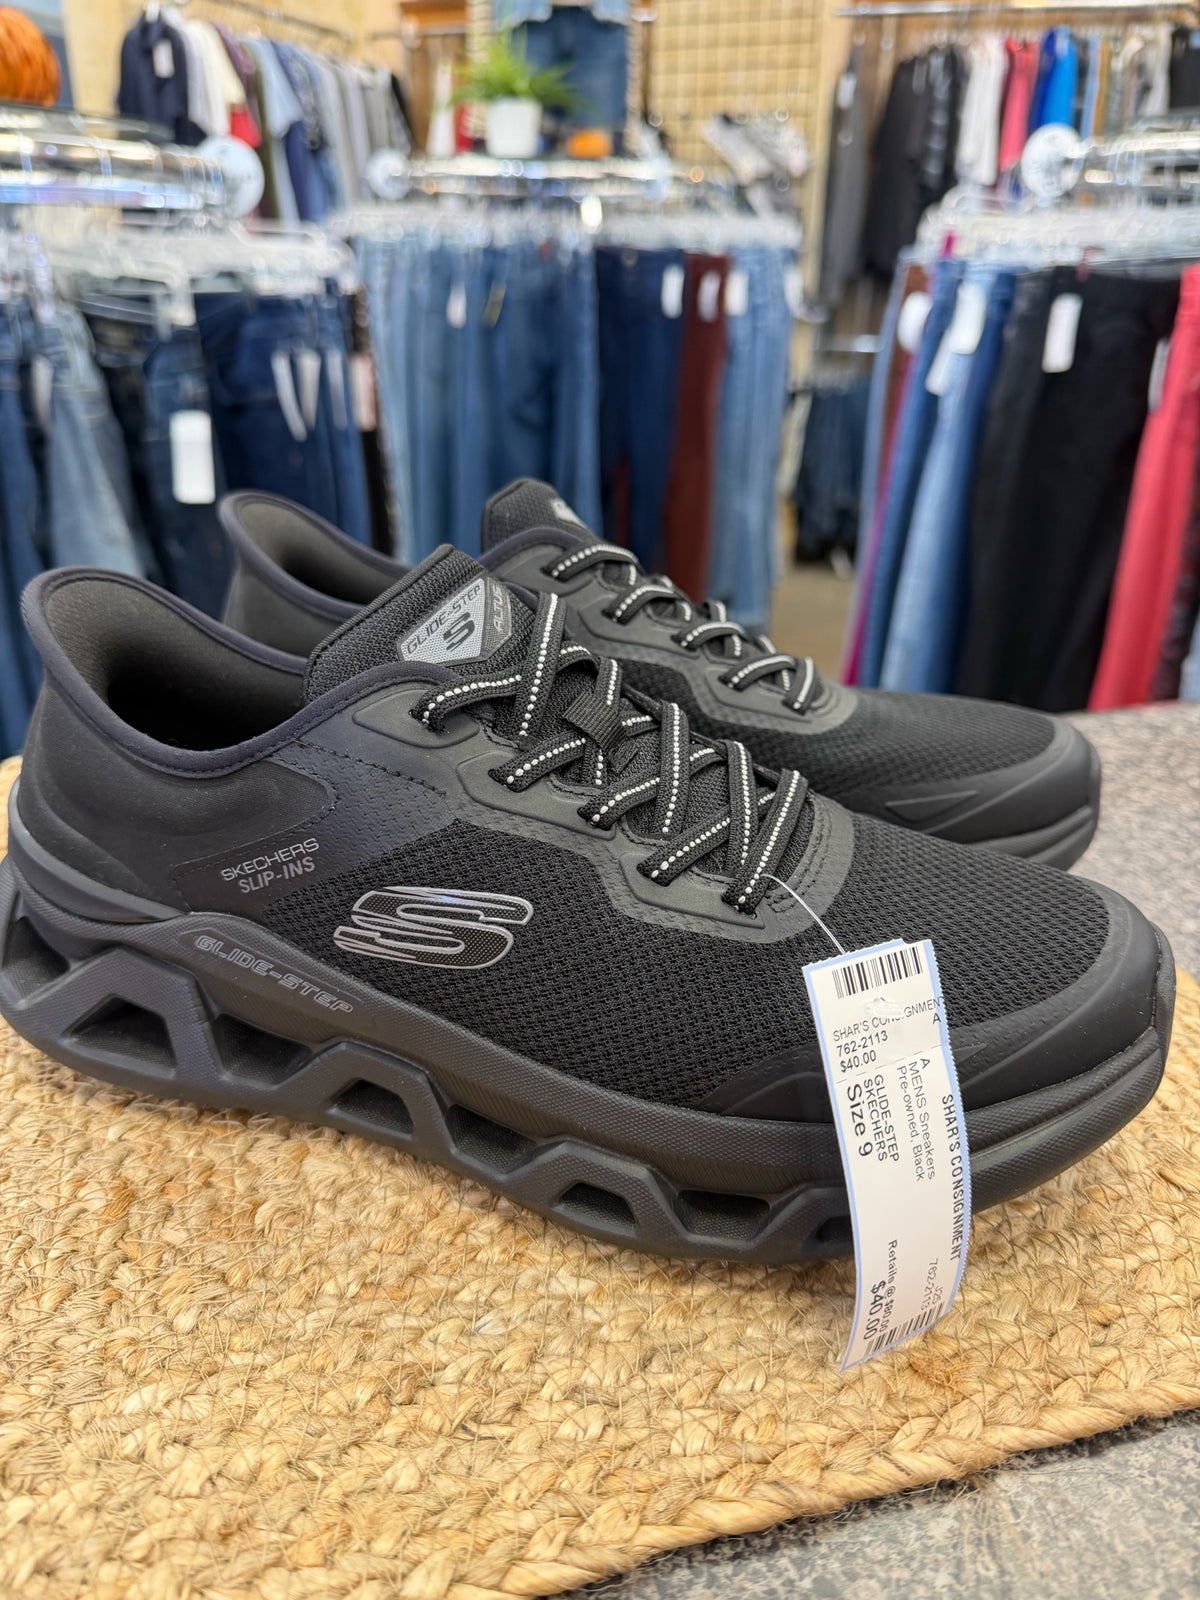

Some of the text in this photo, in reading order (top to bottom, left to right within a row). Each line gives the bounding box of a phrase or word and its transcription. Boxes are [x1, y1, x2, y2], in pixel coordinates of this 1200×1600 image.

[405, 585, 481, 655] GLIDE-STEP
[221, 838, 320, 882] SKECHERS
[238, 857, 316, 893] SLIP-INS
[194, 935, 354, 1013] GLIDE-STEP
[832, 996, 945, 1042] SHAR'S COGNMEN
[932, 1012, 942, 1025] A
[836, 1030, 889, 1058] 762-2113
[840, 1049, 877, 1074] $40.00
[920, 1057, 931, 1069] A
[846, 1083, 874, 1157] Size 9
[863, 1078, 888, 1162] SKECHERS
[874, 1074, 900, 1162] GLIDE-STEP
[908, 1060, 936, 1180] MENS Sneakers
[912, 1144, 925, 1182] Black
[941, 1094, 965, 1261] SHAR'S CONSIGNMENT
[887, 1239, 898, 1285] Retails
[920, 1257, 939, 1311] 762-2113
[862, 1279, 887, 1340] $40.00
